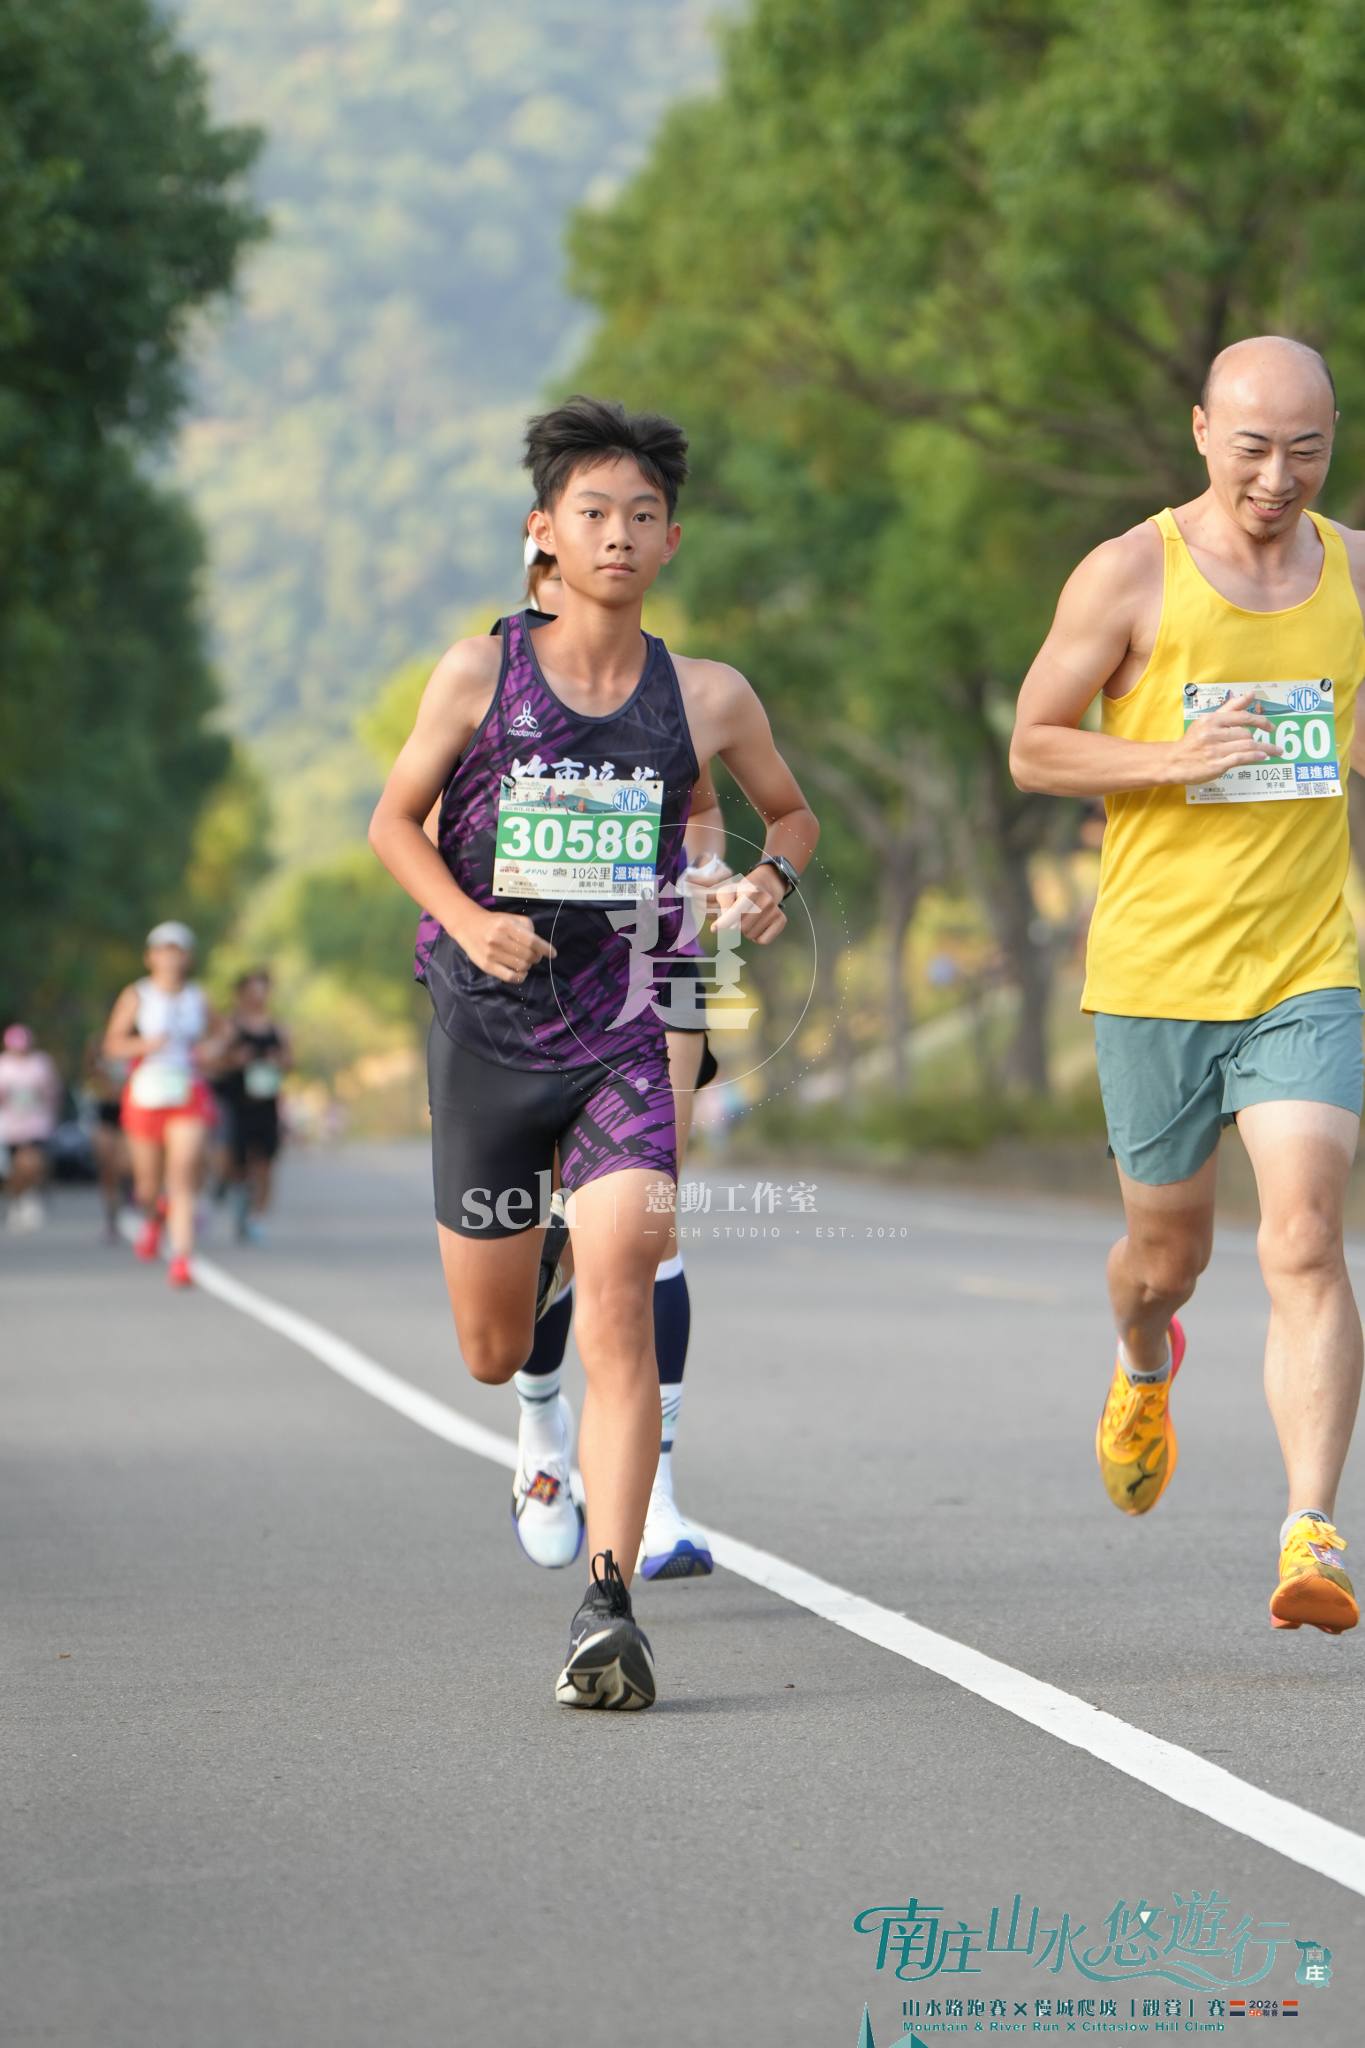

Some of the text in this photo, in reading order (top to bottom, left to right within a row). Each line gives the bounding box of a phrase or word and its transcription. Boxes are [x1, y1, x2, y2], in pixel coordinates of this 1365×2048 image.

[1255, 767, 1293, 780] 10公里
[501, 816, 654, 860] 30586
[571, 867, 611, 880] 10公里
